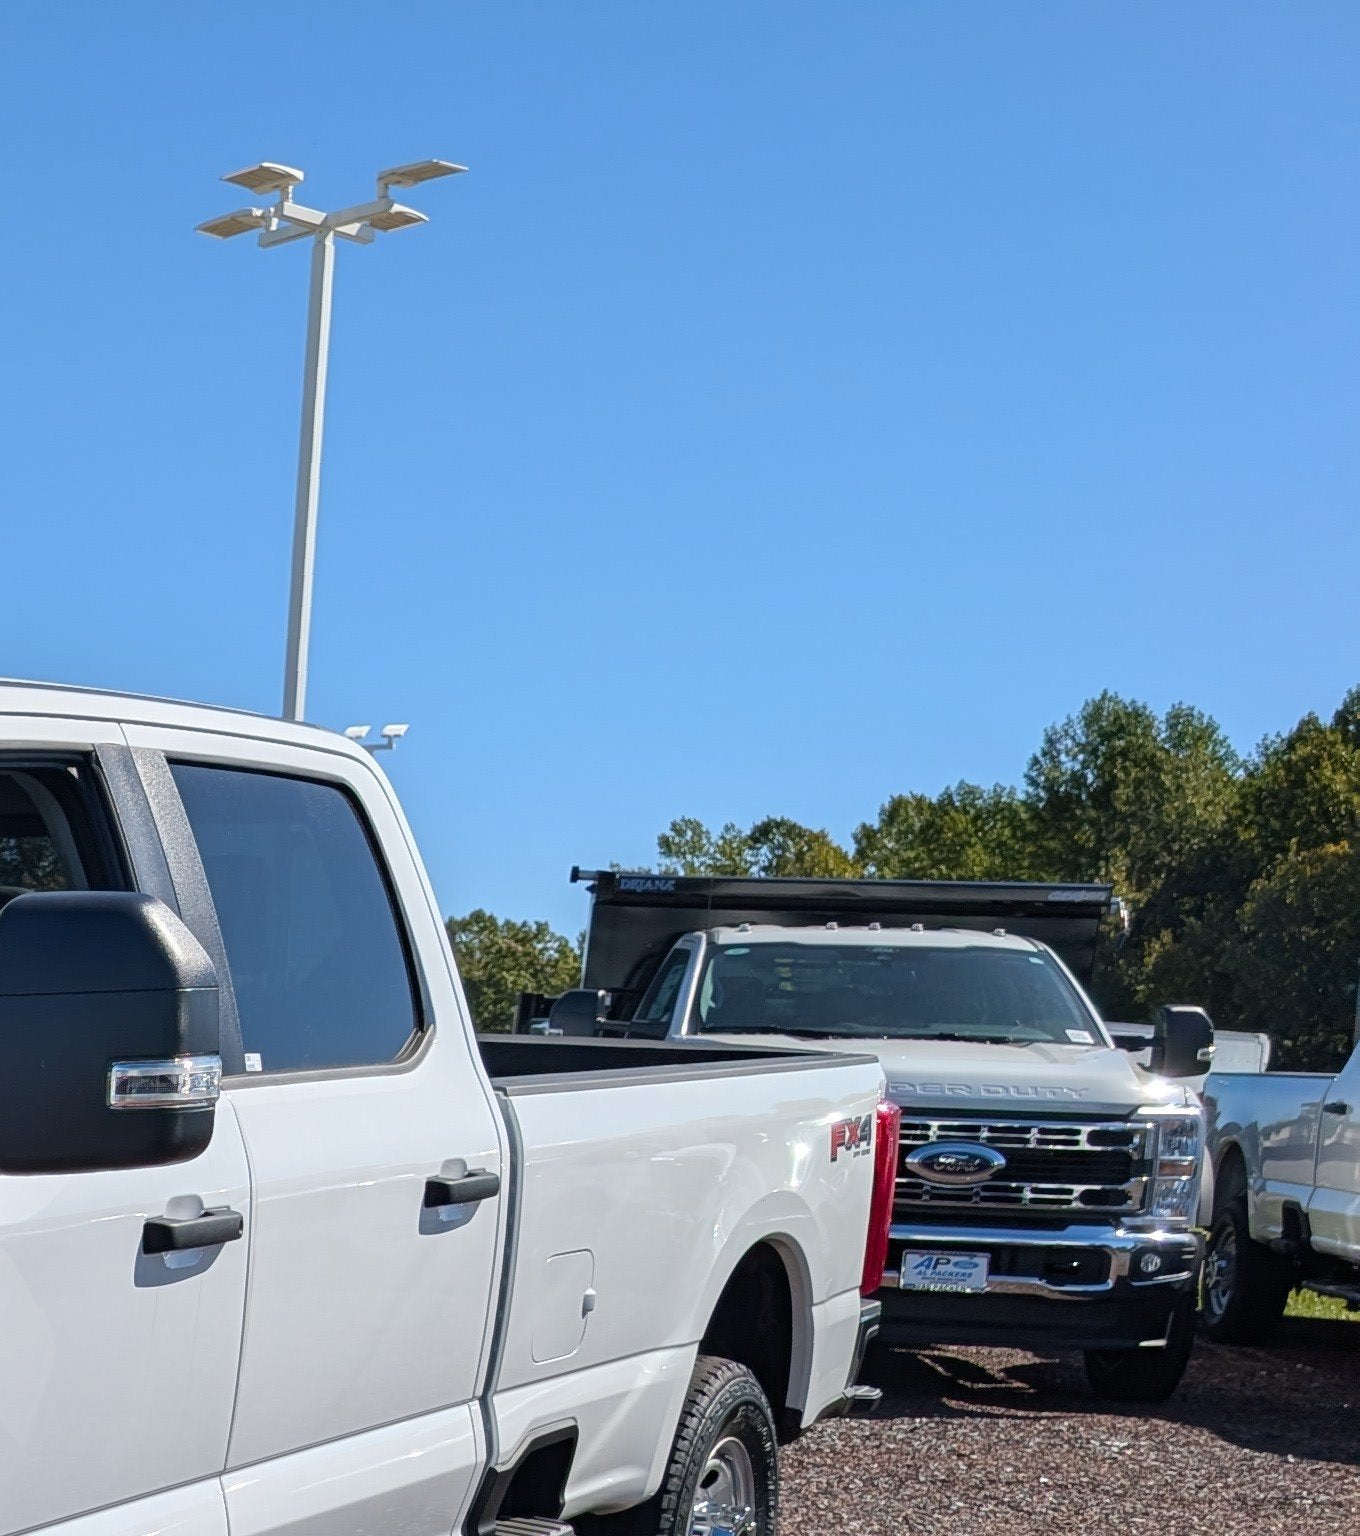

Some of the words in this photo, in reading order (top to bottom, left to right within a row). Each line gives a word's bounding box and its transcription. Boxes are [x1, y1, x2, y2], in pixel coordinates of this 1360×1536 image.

[888, 1081, 972, 1096] PER
[980, 1084, 1090, 1099] DUTY
[830, 1114, 872, 1163] FX4
[912, 1256, 951, 1270] AP
